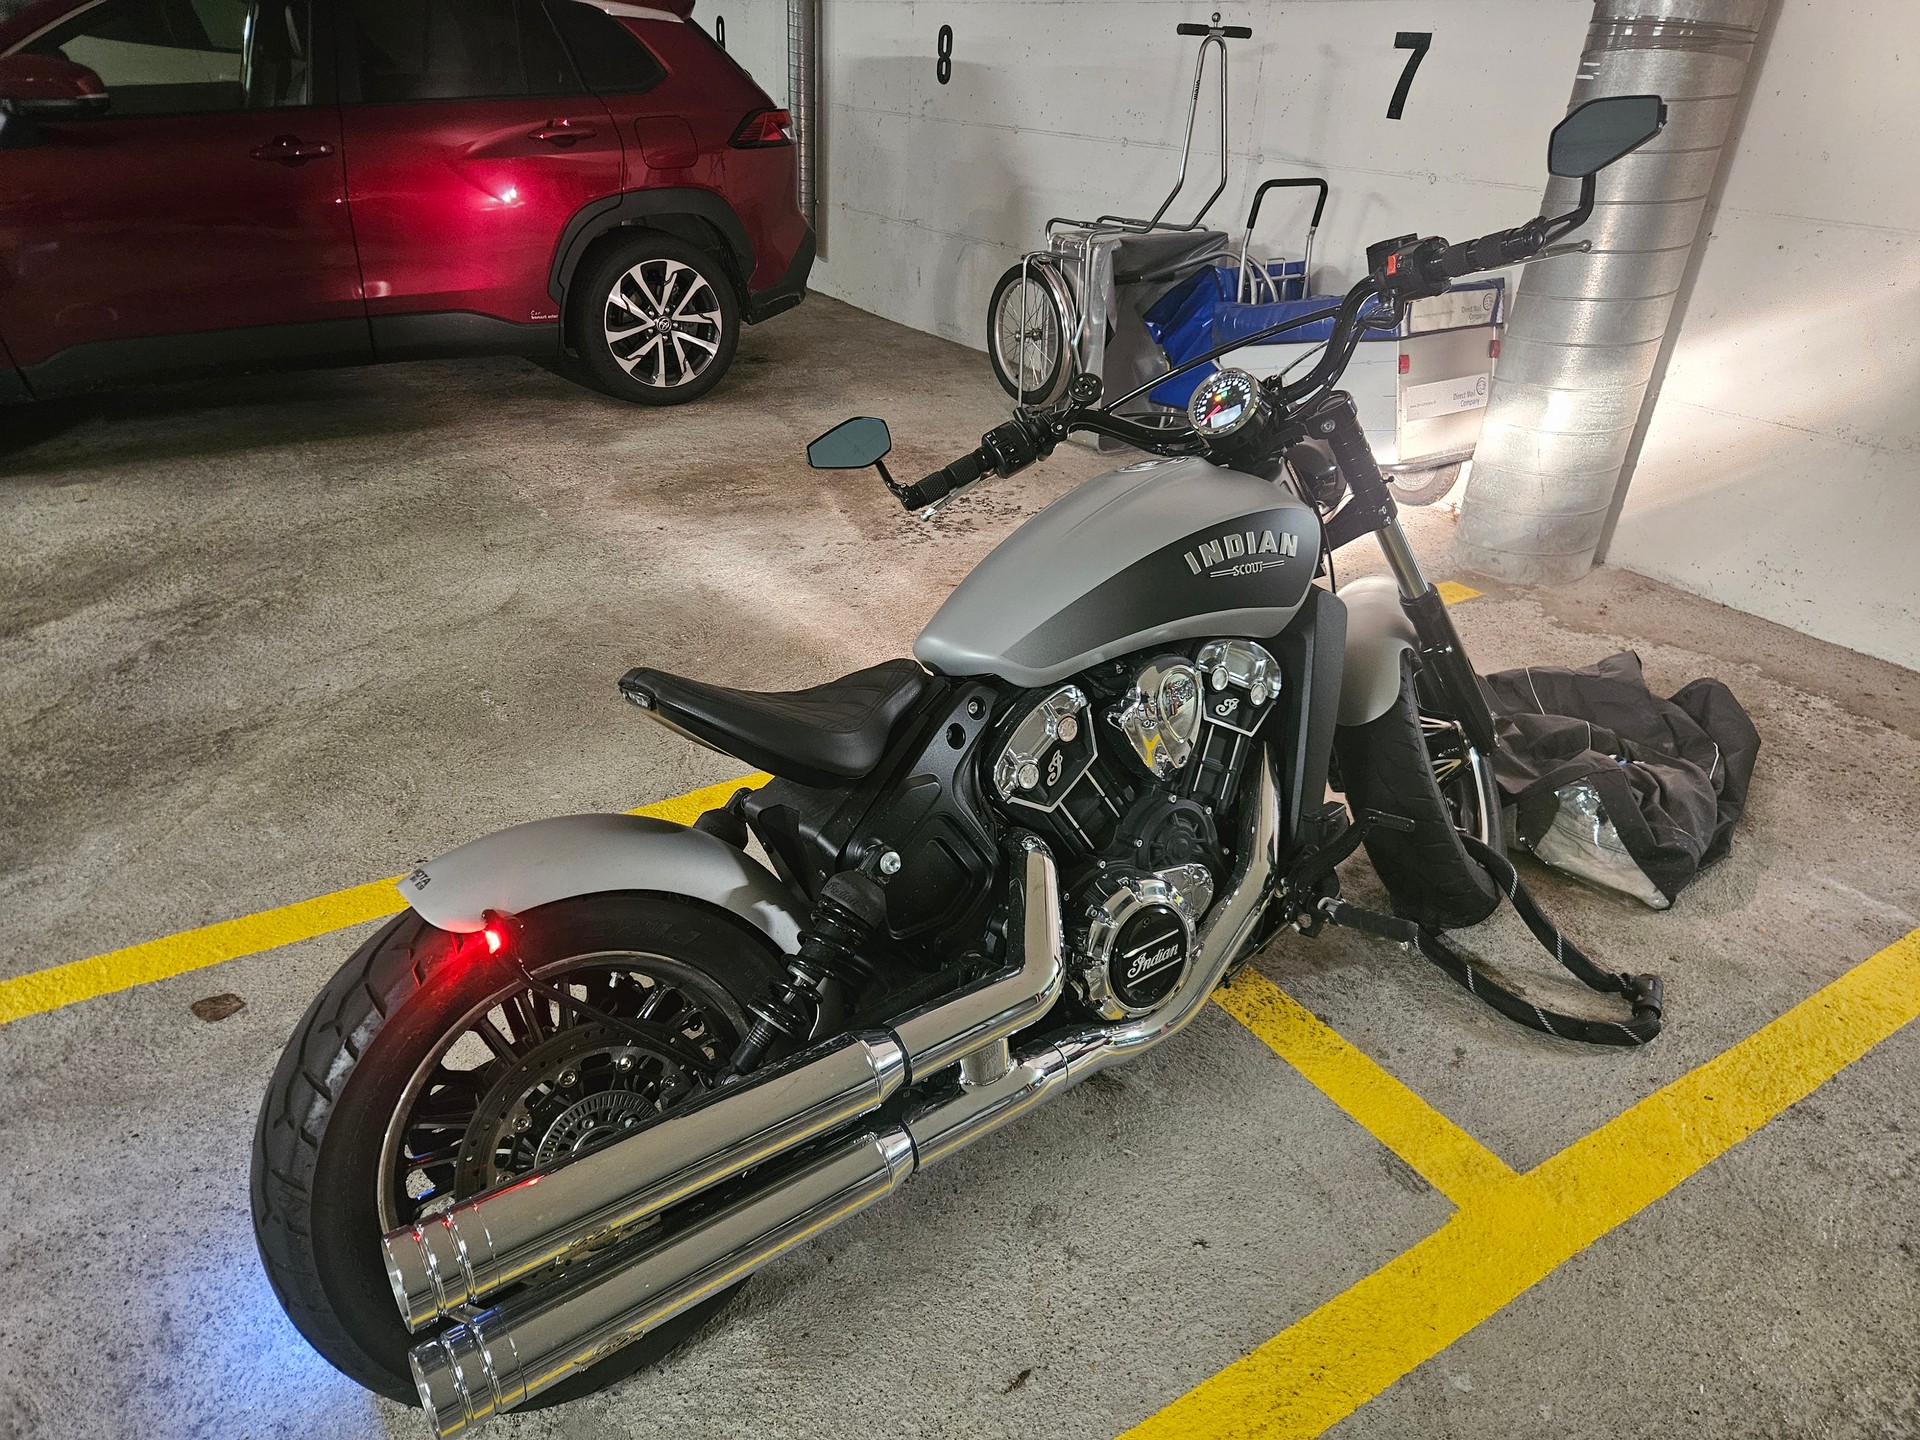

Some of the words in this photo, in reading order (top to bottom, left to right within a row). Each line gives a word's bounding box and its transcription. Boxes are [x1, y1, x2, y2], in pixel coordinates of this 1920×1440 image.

[937, 24, 953, 85] 8
[1386, 32, 1432, 120] 7
[1452, 391, 1466, 400] Direct
[1466, 389, 1476, 398] Mail
[1460, 398, 1480, 408] Company
[1184, 530, 1298, 575] INDIAN
[1233, 561, 1263, 576] SCOUT
[1127, 944, 1179, 979] Indian
